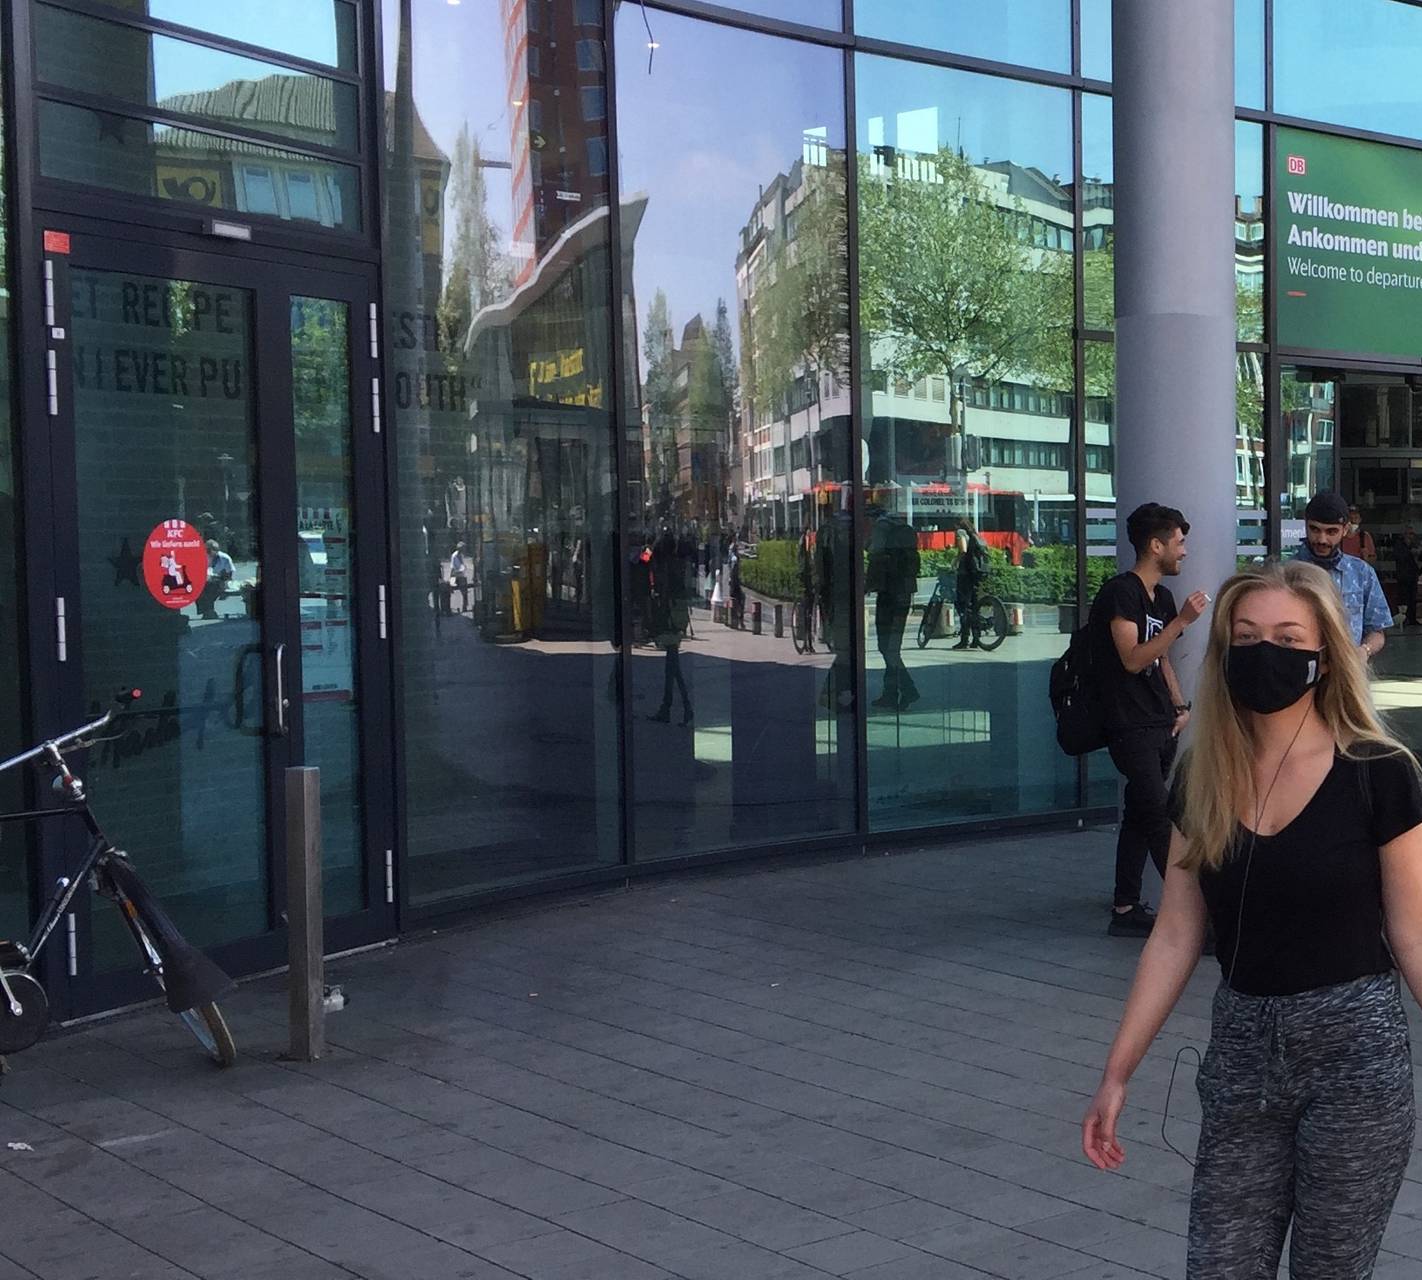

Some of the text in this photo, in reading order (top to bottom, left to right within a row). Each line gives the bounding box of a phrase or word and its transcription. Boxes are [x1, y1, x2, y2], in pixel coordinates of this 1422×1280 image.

[1288, 157, 1305, 174] DB
[1288, 191, 1399, 228] Willkommen
[1287, 223, 1389, 257] Ankommen
[1288, 256, 1347, 281] Welcome
[1350, 267, 1364, 282] to
[122, 281, 233, 333] RECPE
[115, 349, 188, 396] EVER
